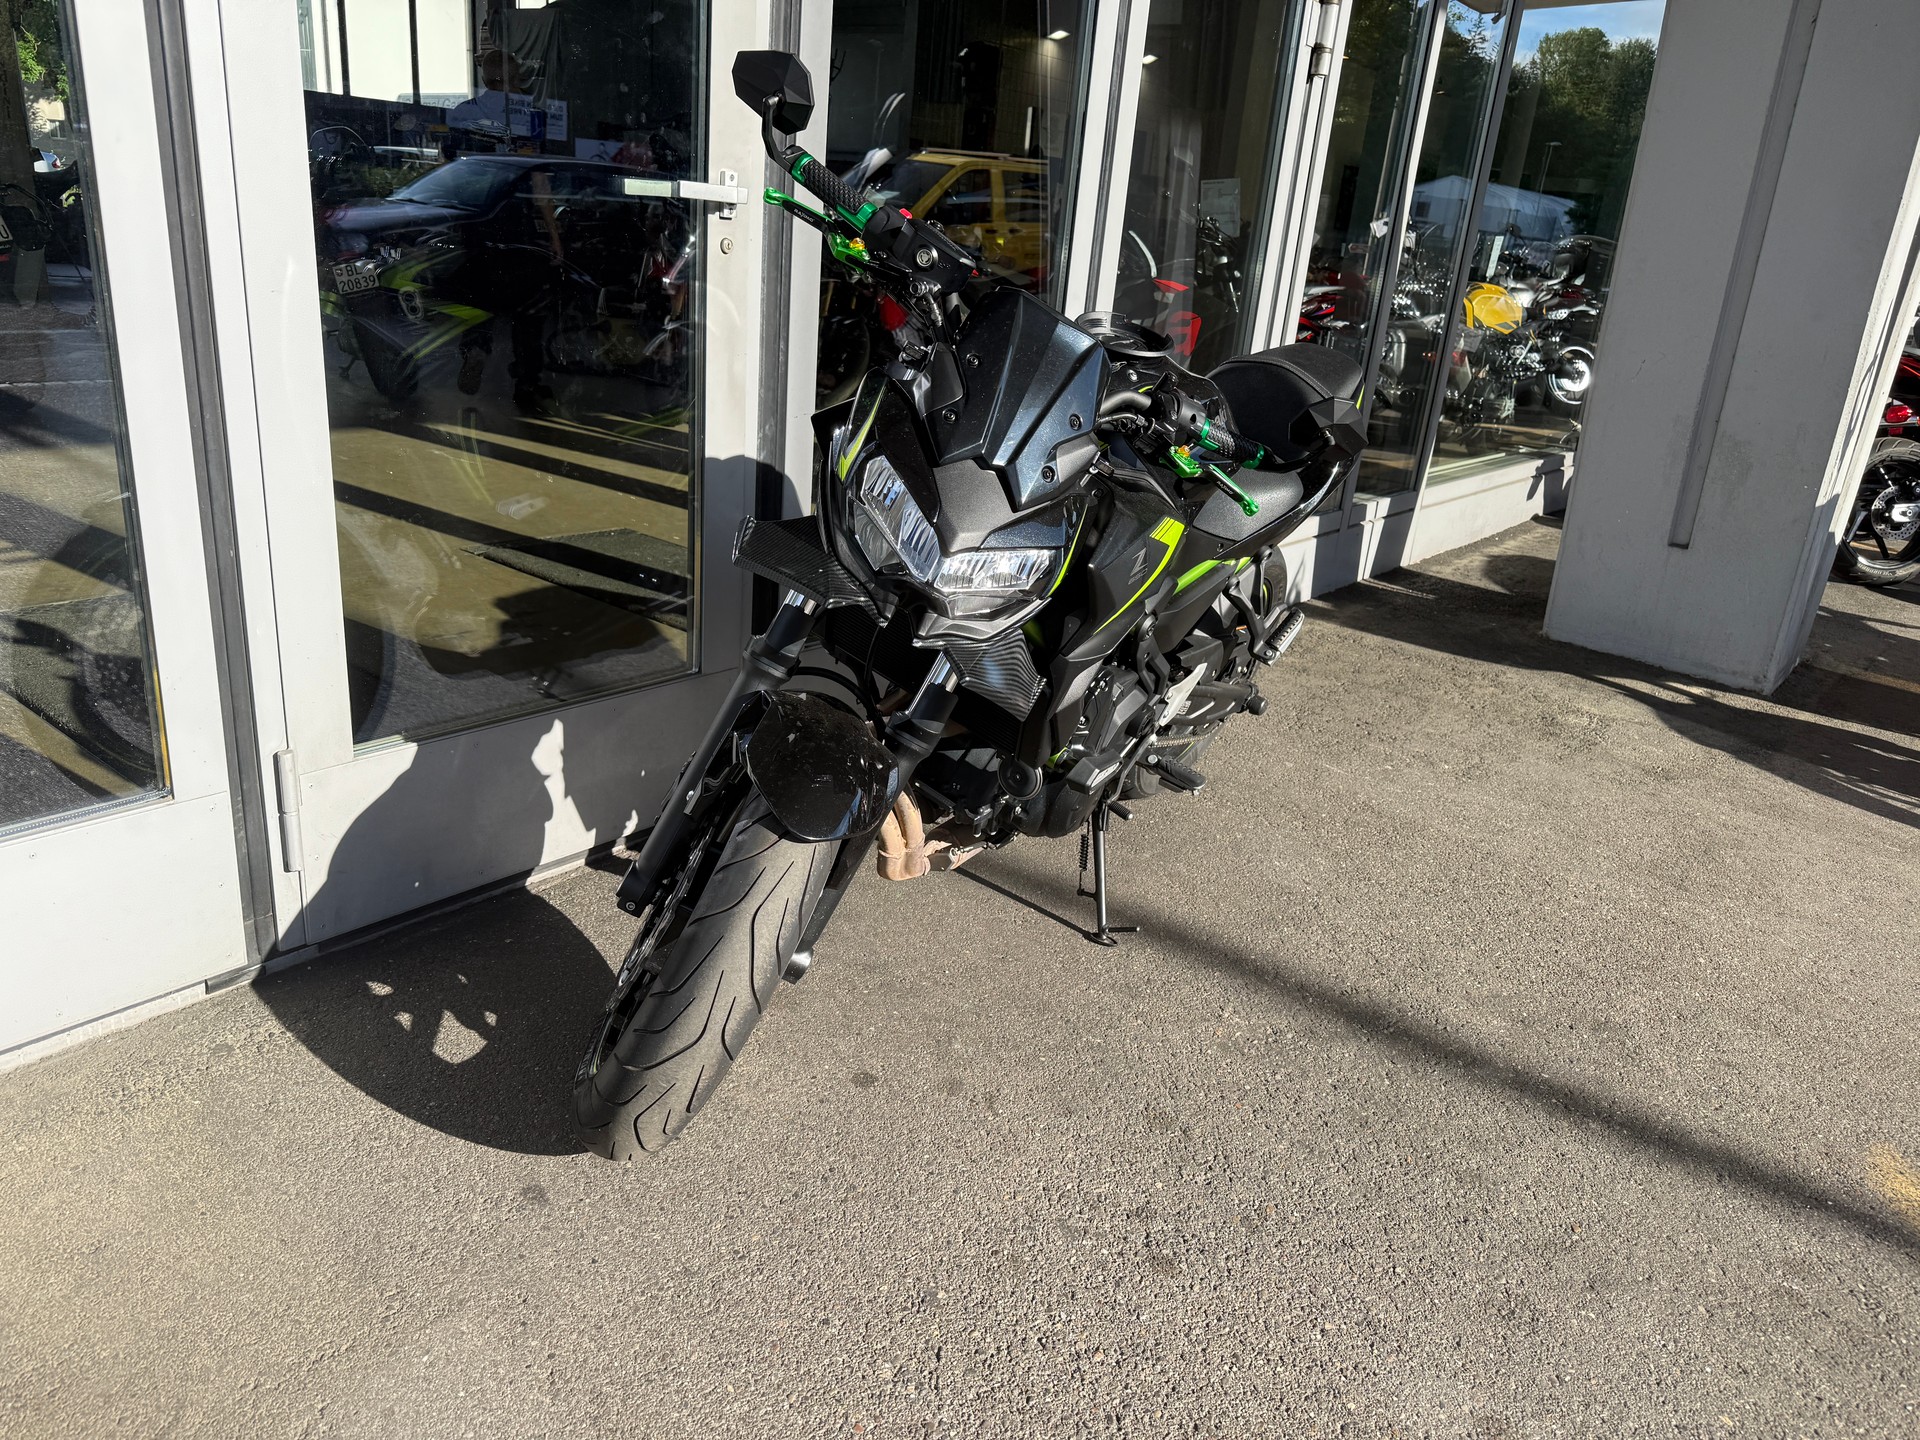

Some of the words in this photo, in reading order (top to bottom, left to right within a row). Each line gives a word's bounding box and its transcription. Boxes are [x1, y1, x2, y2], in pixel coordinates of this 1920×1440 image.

[345, 264, 363, 277] BL
[339, 274, 376, 293] 20839
[1131, 547, 1149, 577] Z
